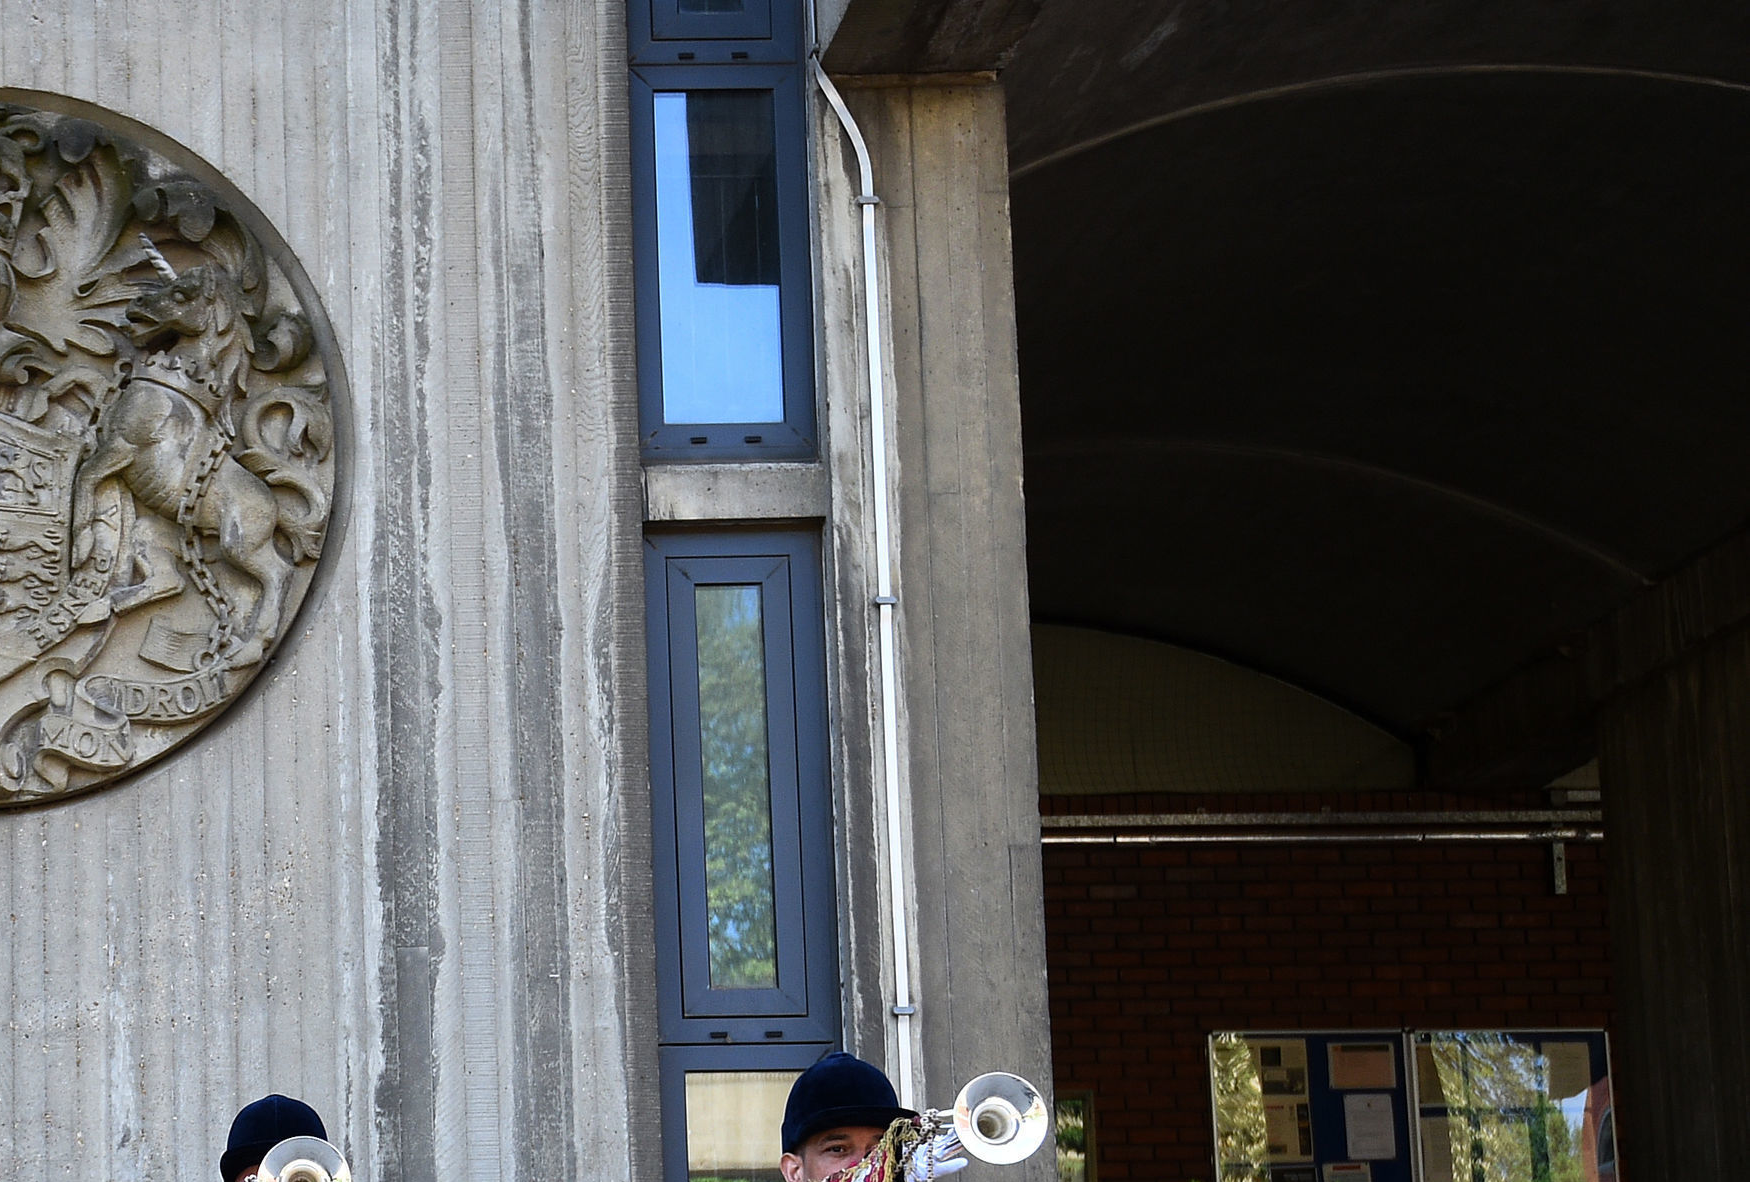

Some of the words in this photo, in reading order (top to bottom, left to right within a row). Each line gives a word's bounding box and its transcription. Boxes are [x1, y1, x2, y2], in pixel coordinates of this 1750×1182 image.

[93, 503, 118, 532] Y
[38, 724, 134, 763] MON
[123, 668, 230, 717] DROIT
